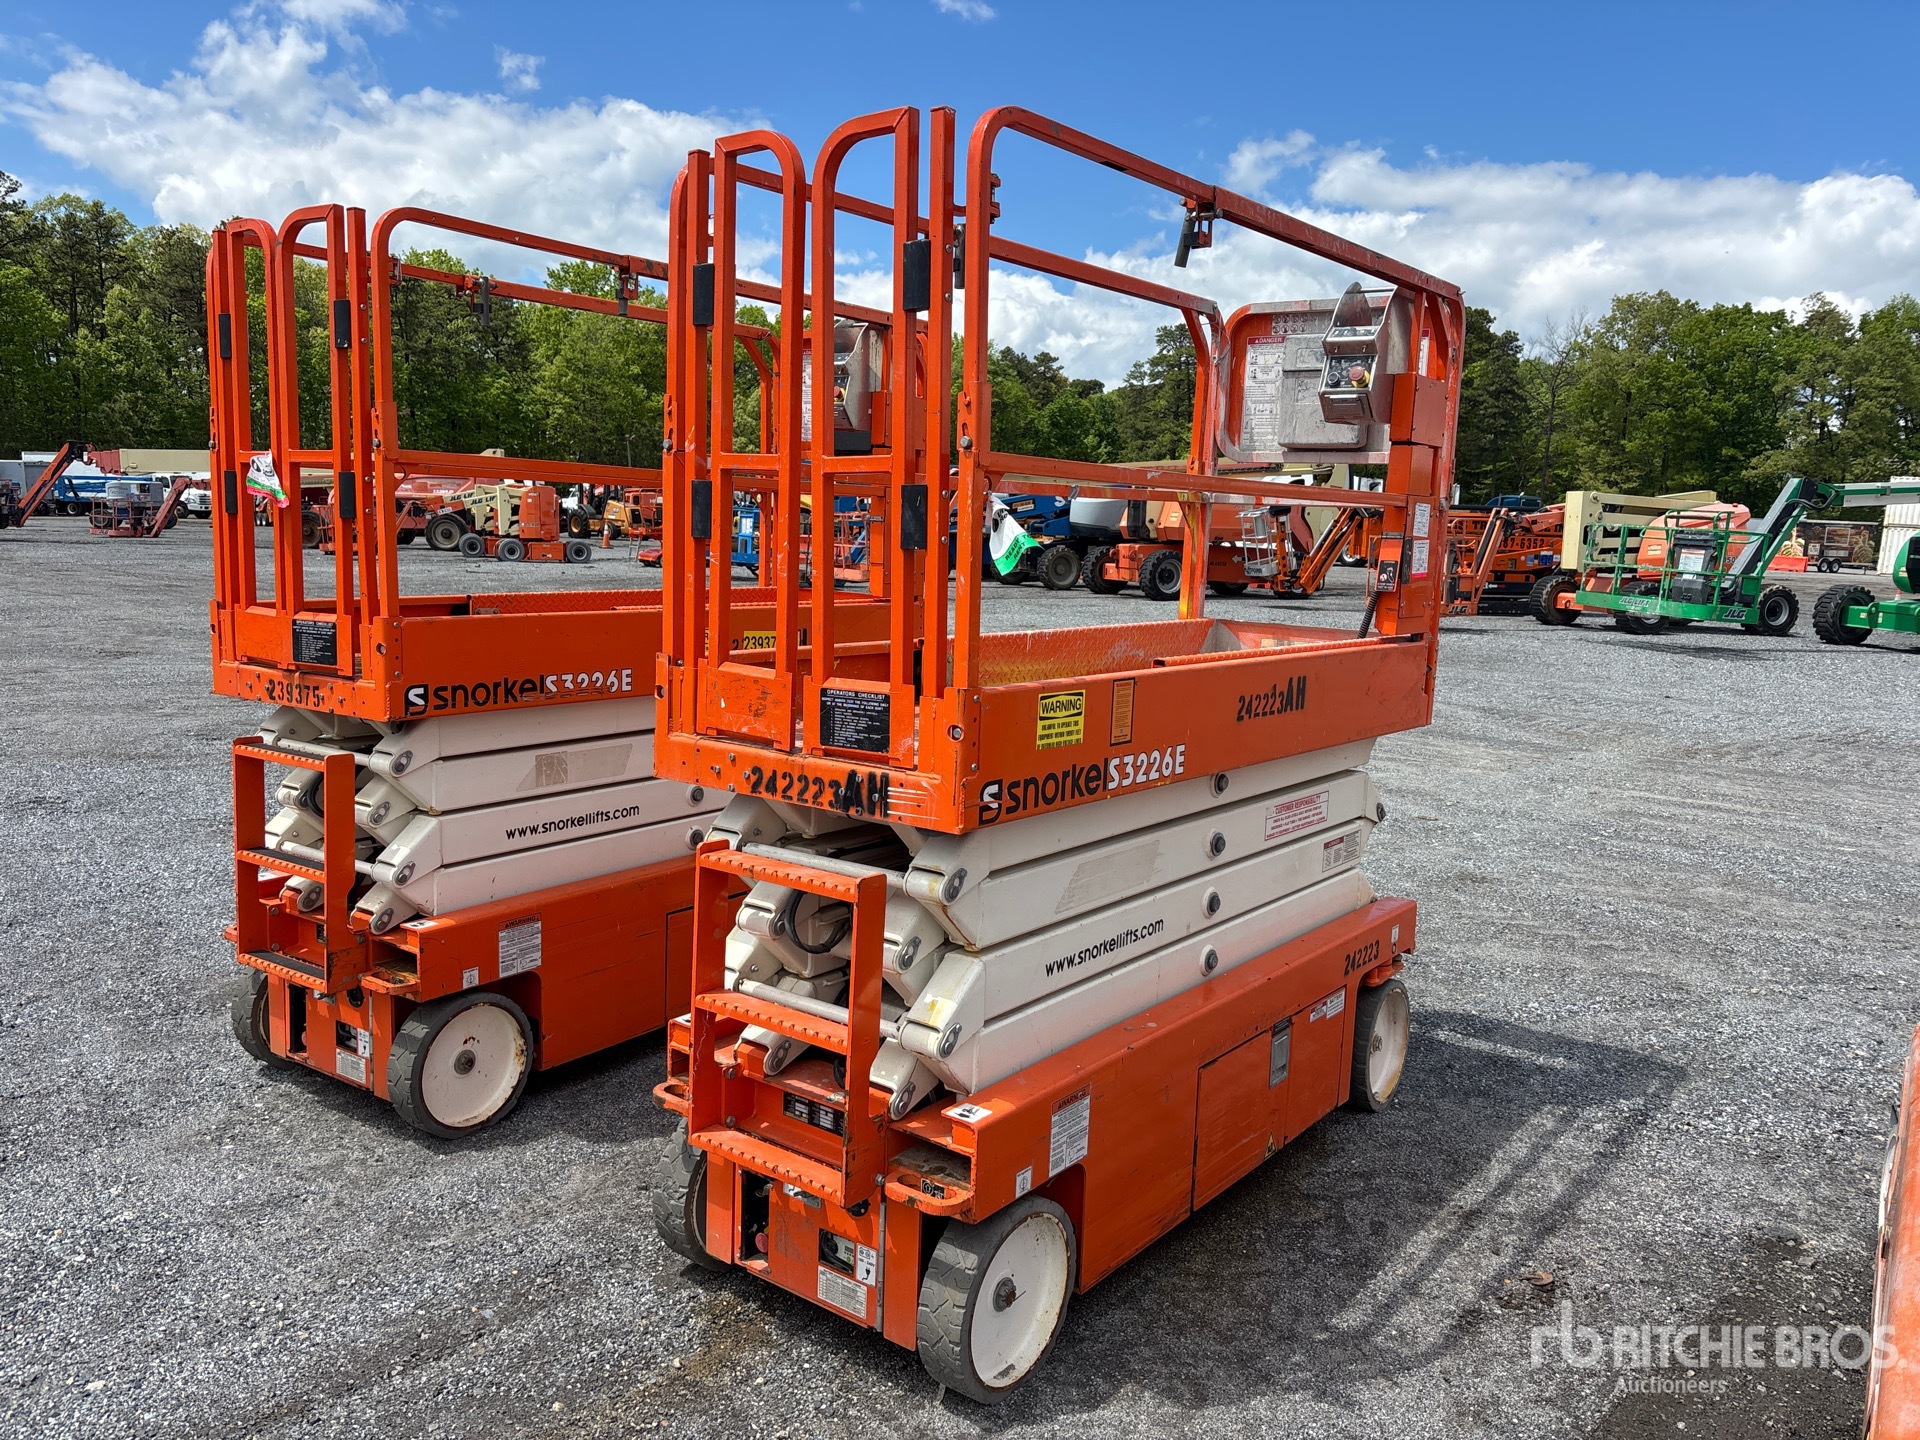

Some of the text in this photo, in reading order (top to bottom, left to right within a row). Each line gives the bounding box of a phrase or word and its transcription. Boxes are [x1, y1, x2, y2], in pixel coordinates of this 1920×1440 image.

[470, 498, 483, 506] JLG
[1723, 608, 1747, 619] JLG
[268, 678, 321, 708] 239375
[433, 675, 545, 711] snorkel
[826, 689, 886, 700] OPERATORS CHECKLIST
[1041, 698, 1082, 715] WARNING
[1006, 757, 1109, 815] snorkel
[1107, 743, 1187, 791] S3226E
[505, 805, 641, 841] www.snorkellifts.com
[1045, 918, 1165, 978] www.snorkellifts.com
[1343, 939, 1381, 978] 242223
